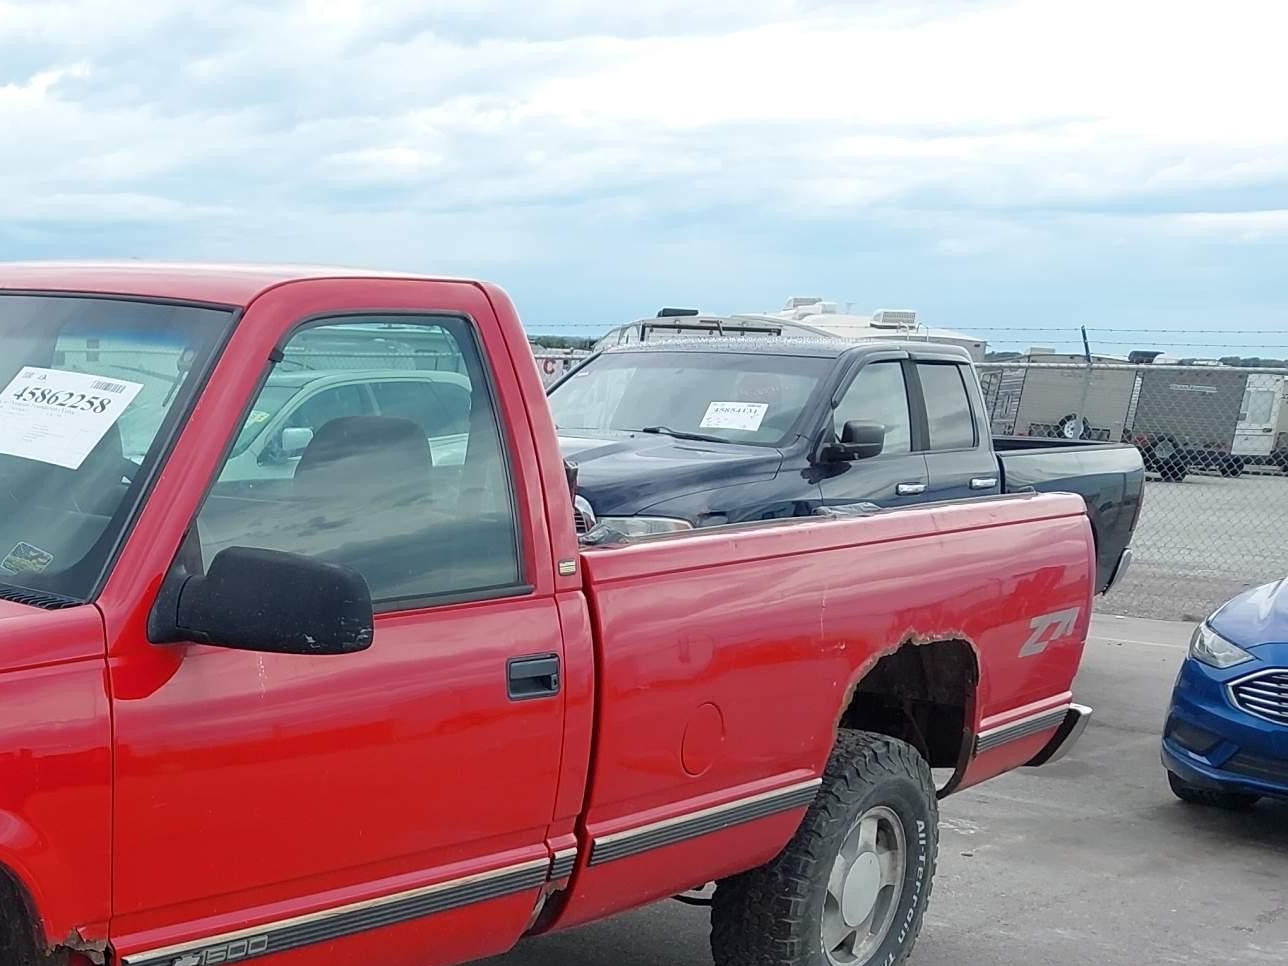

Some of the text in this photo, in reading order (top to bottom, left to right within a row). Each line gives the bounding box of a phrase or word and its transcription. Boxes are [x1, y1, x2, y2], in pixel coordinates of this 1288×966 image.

[13, 385, 112, 415] 45862258
[1017, 607, 1081, 658] Z71
[897, 819, 928, 945] All-Terrain
[201, 934, 269, 966] 1500
